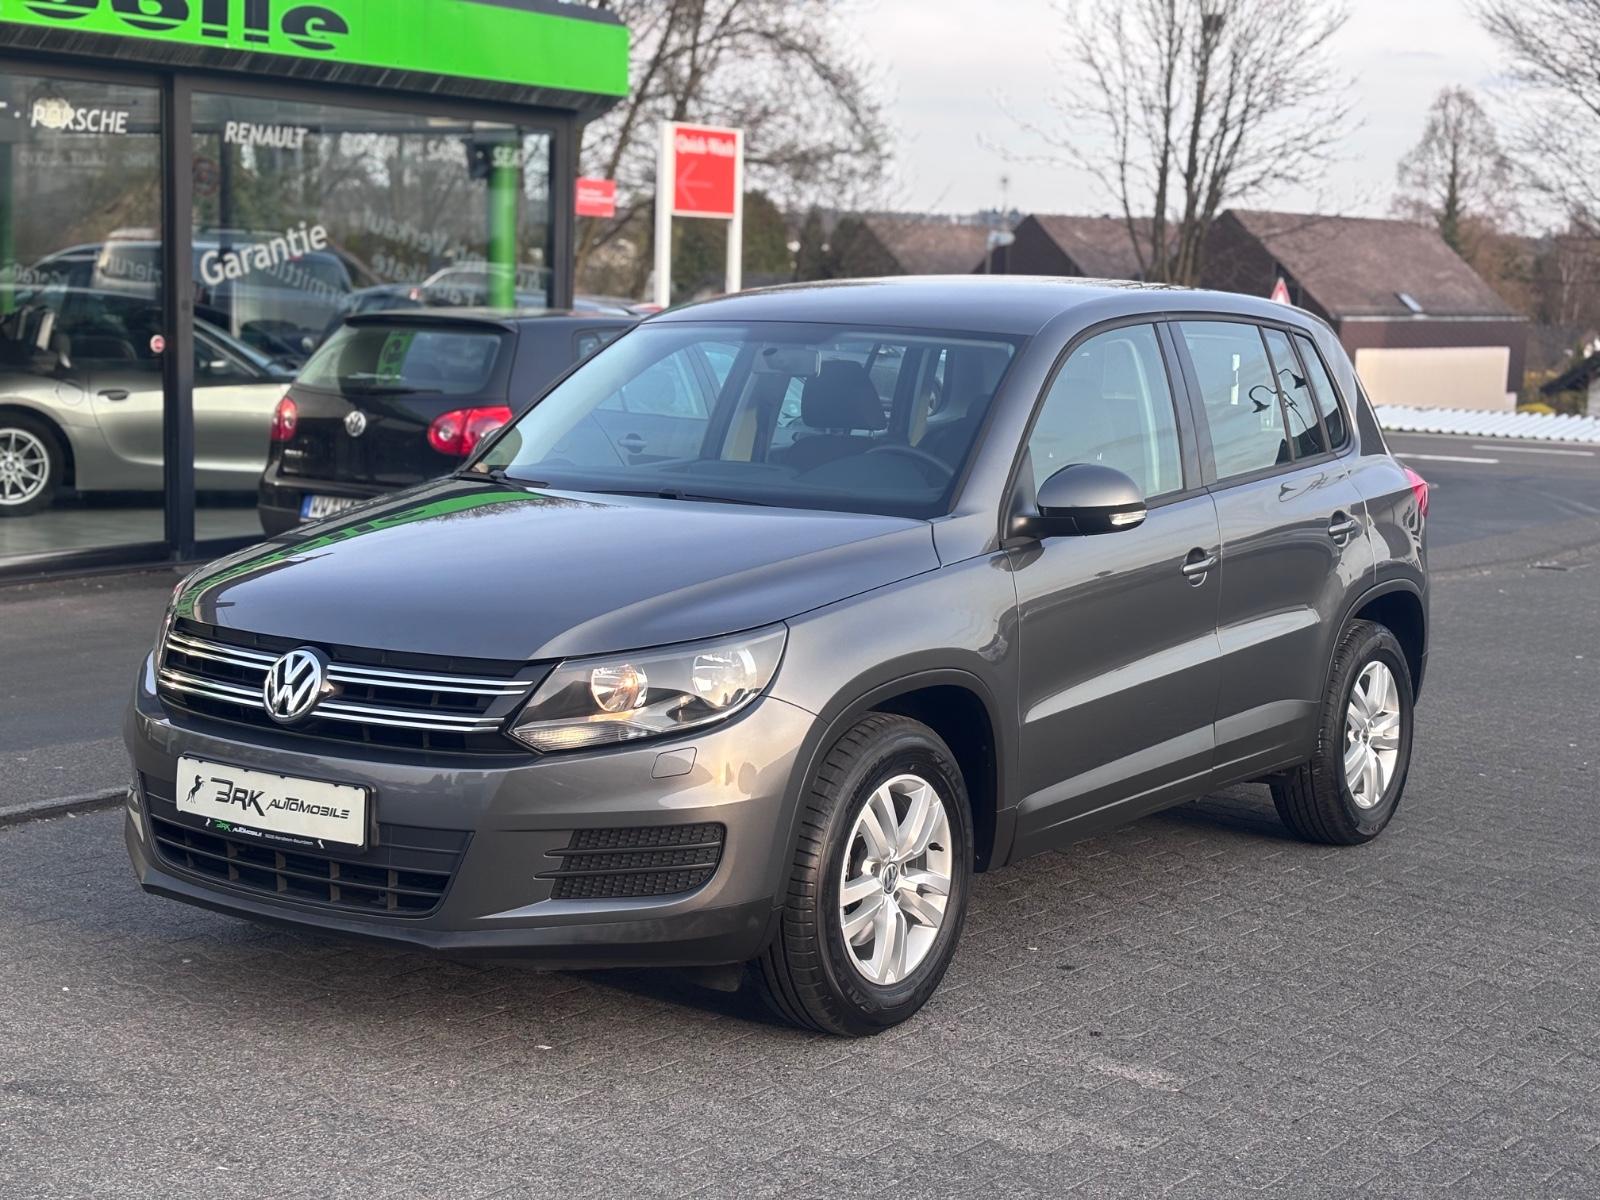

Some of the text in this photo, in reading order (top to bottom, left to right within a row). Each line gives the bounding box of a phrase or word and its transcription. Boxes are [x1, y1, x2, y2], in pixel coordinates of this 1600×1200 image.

[31, 103, 129, 134] PORSCHE
[225, 121, 308, 148] RENAULT
[200, 221, 327, 286] Garantie
[265, 797, 350, 819] AUTOMOBILE
